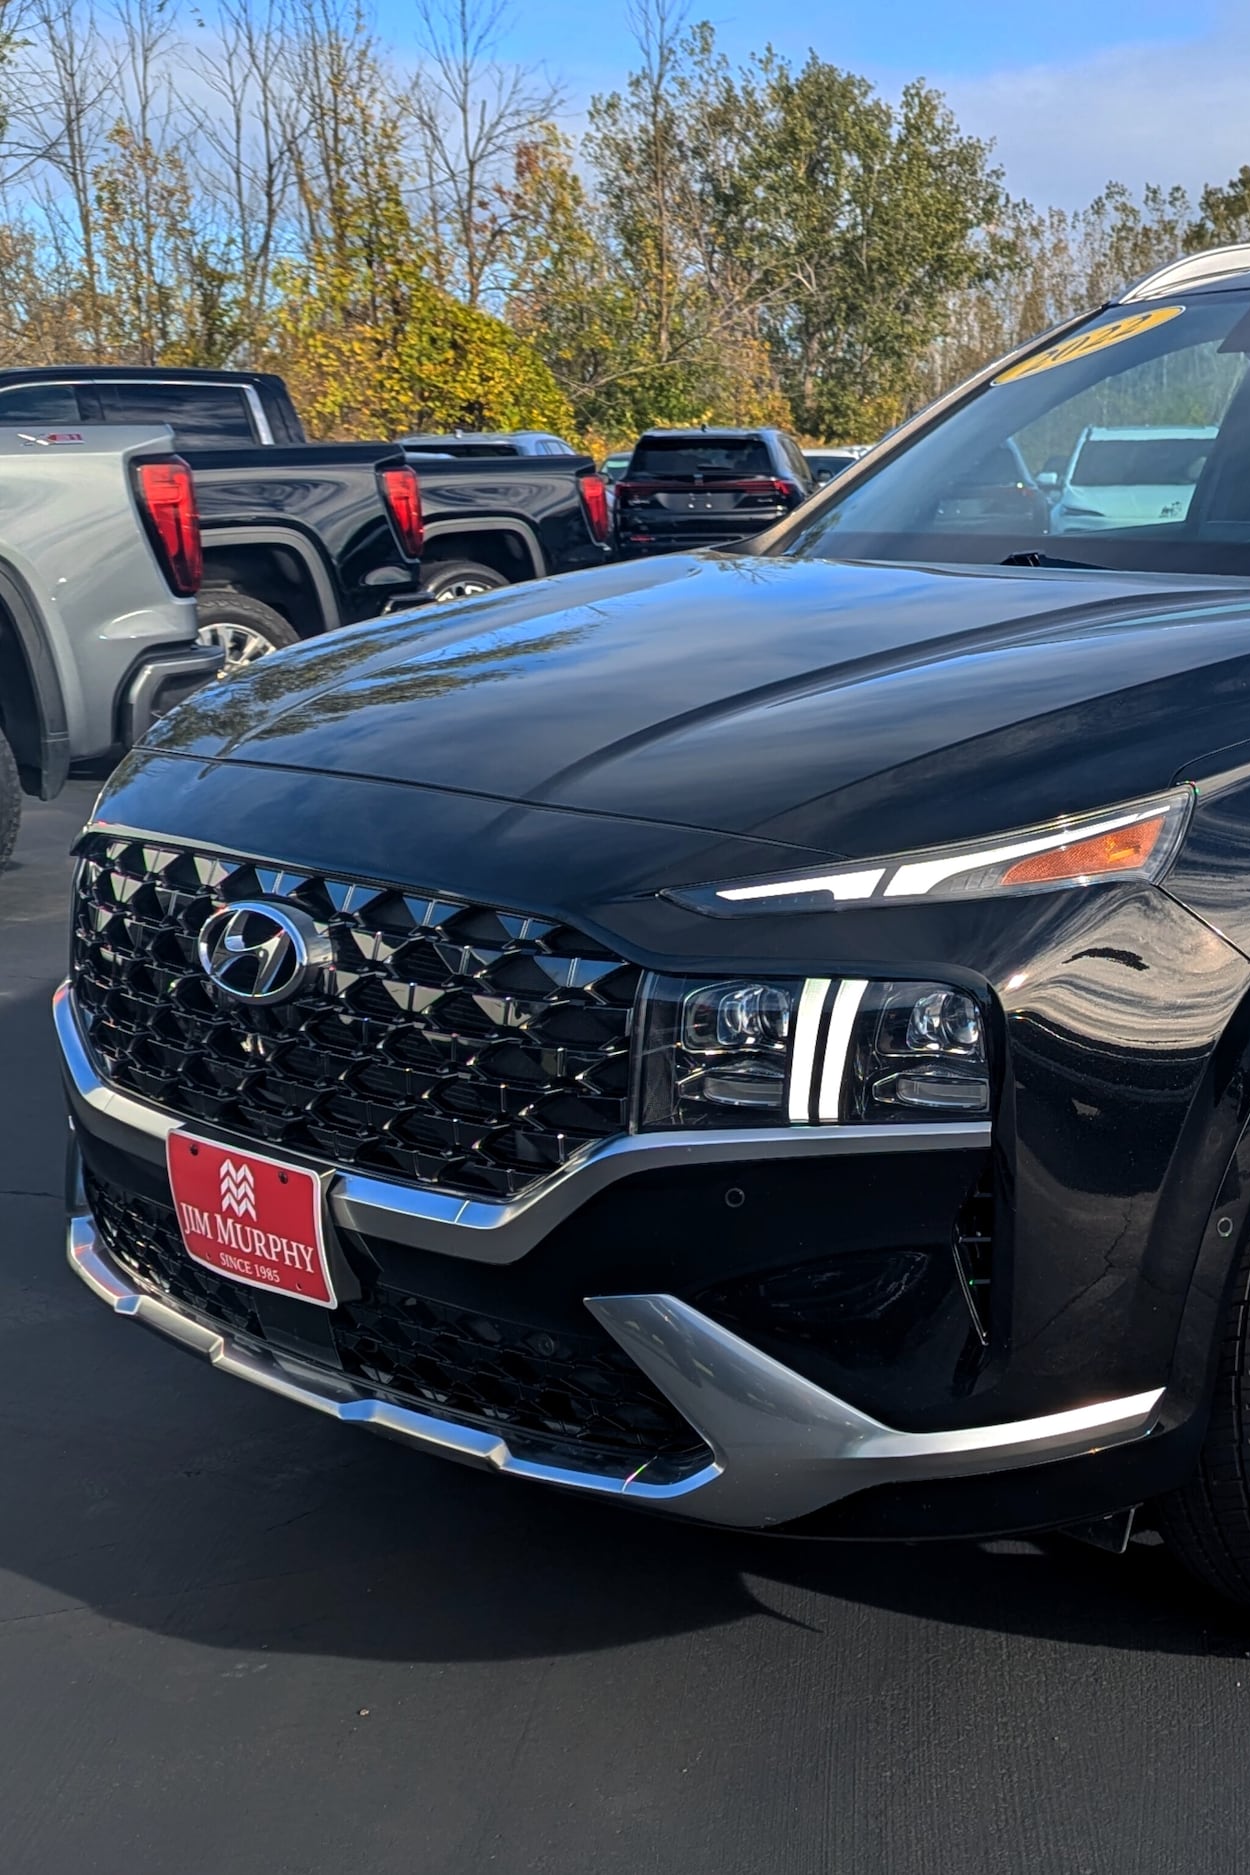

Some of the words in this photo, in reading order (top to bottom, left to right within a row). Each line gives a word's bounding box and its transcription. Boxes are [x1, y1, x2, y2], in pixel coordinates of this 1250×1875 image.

[180, 1202, 214, 1240] JIM
[215, 1213, 315, 1273] MURPHY
[219, 1252, 253, 1275] SINCE
[254, 1264, 280, 1283] 1985
